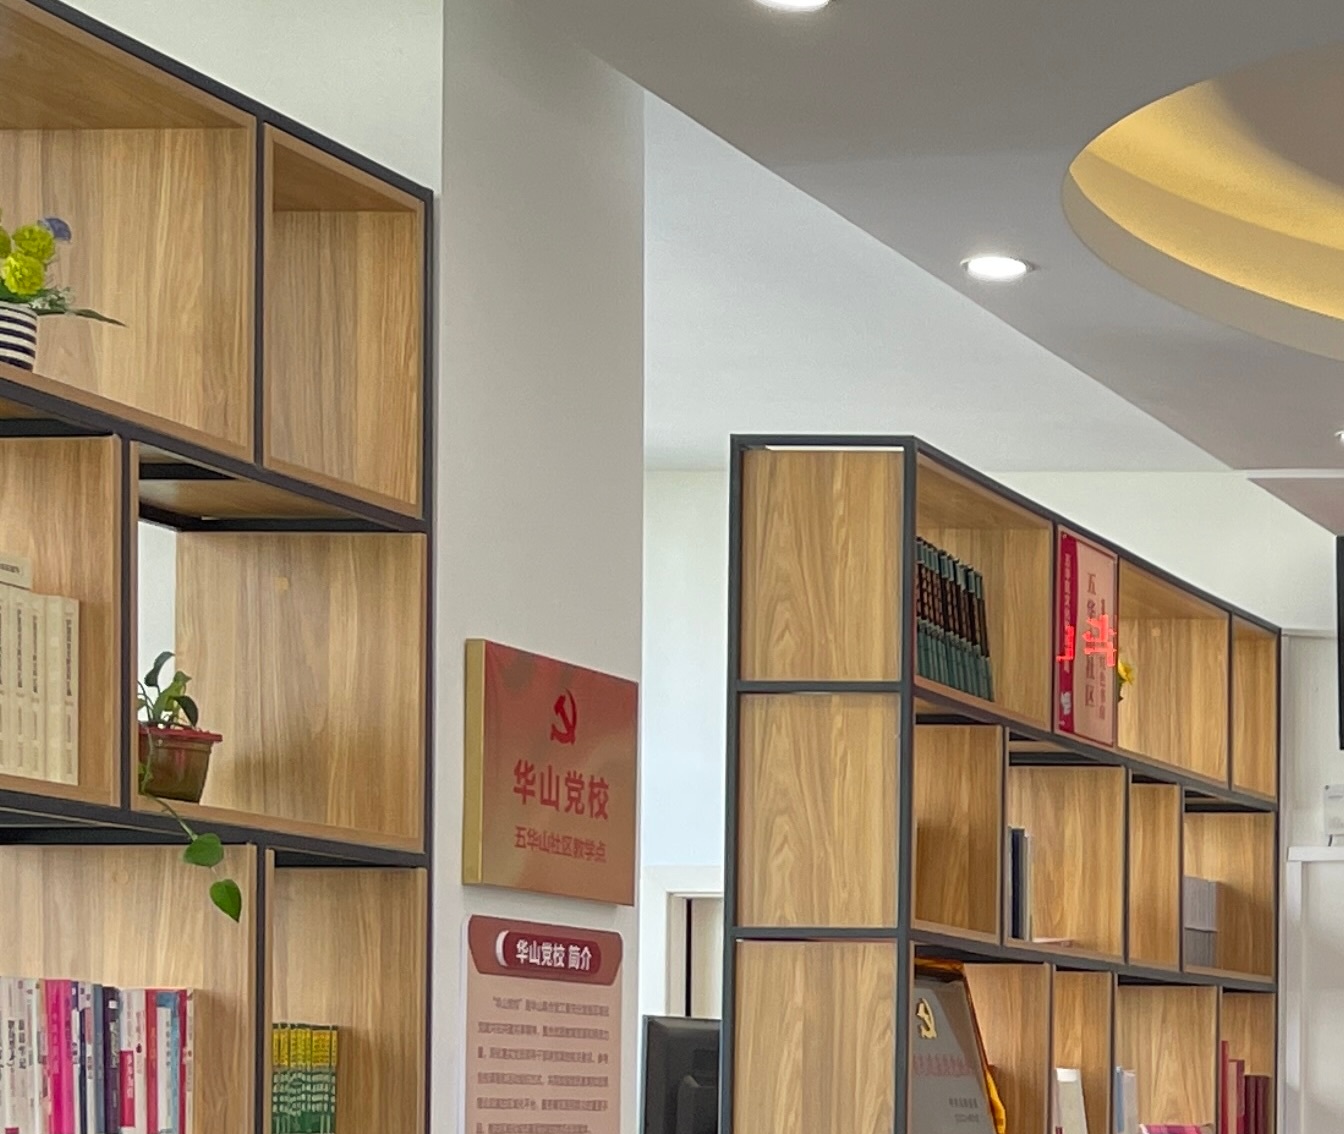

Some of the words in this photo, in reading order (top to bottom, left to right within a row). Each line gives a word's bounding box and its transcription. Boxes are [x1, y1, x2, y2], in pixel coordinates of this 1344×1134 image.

[513, 759, 609, 820] 华山党校
[514, 826, 607, 863] 五华山社区教学点
[515, 939, 566, 968] 华山党校
[567, 944, 593, 971] 简介
